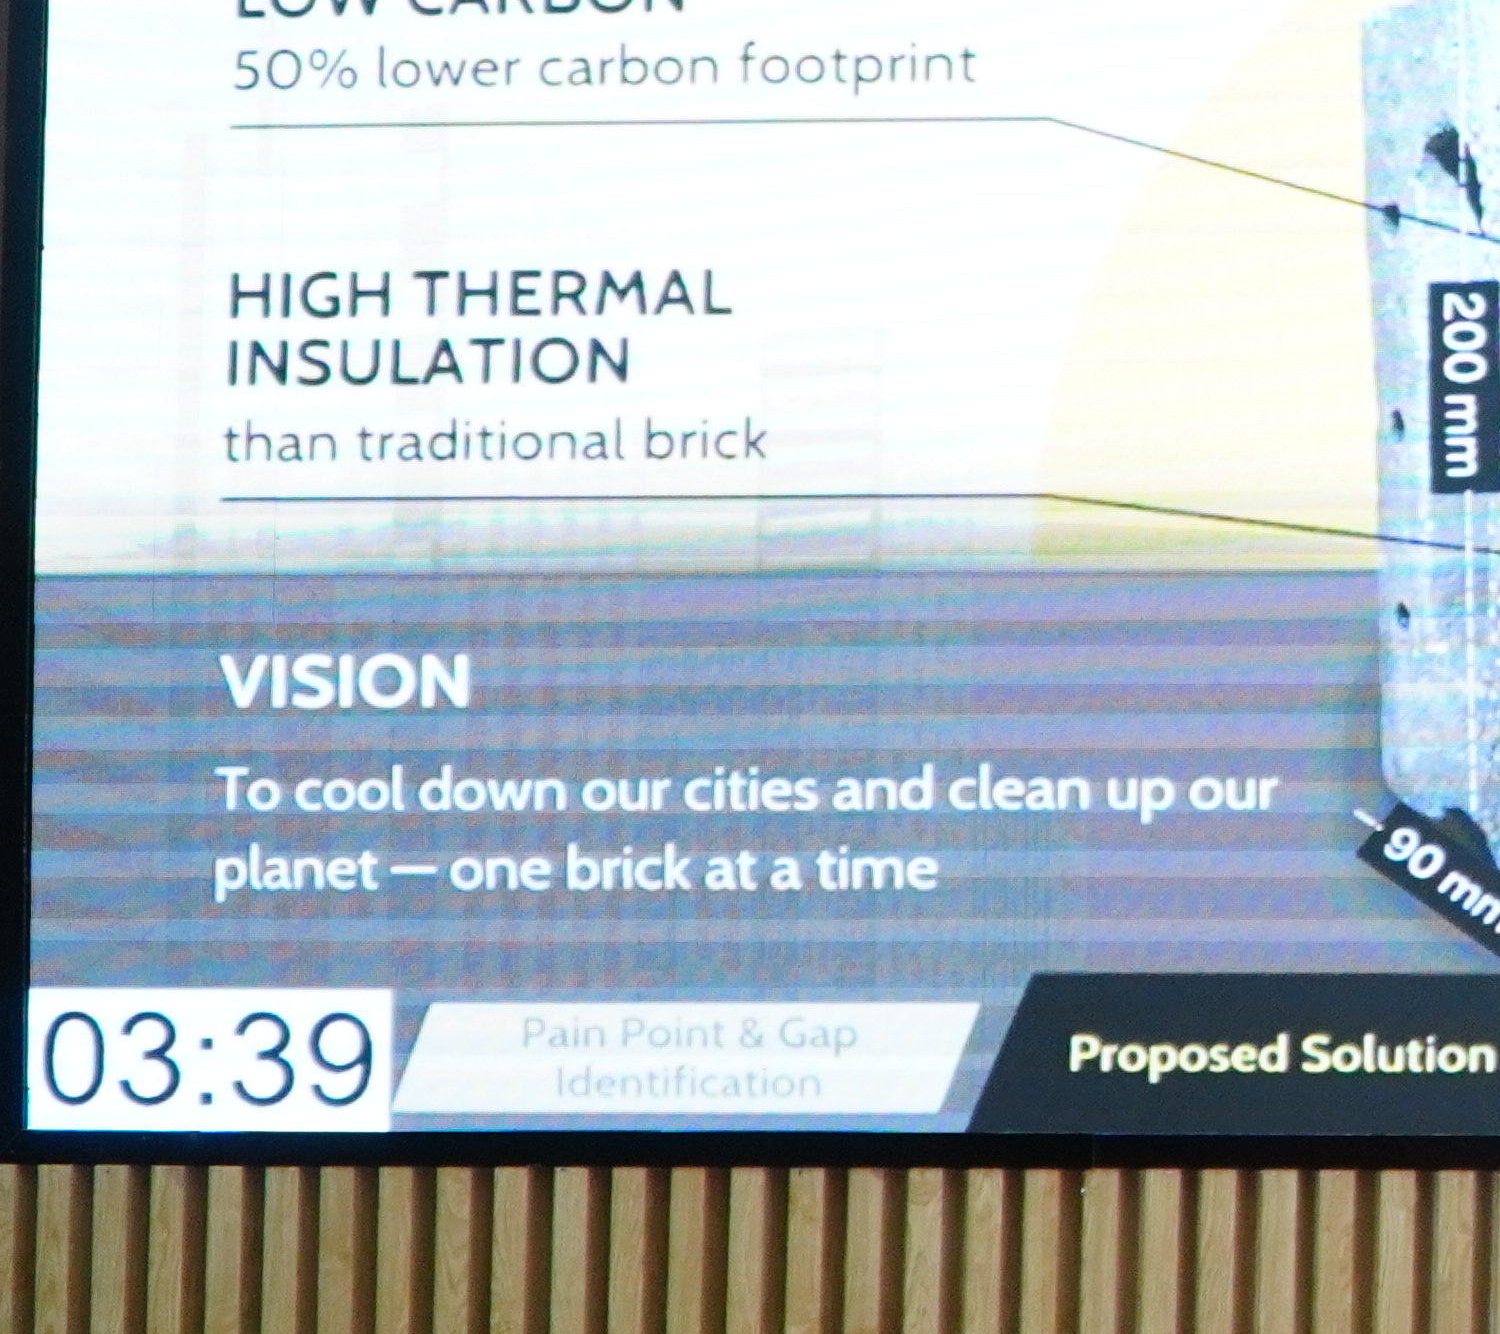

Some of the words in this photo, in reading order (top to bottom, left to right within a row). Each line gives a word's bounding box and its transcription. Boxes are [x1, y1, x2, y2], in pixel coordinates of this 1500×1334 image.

[235, 49, 357, 90] 50%
[379, 45, 520, 88] lower
[540, 43, 718, 86] carbon
[740, 41, 976, 95] footprint
[231, 272, 390, 318] HIGH
[413, 270, 732, 316] THERMAL
[229, 337, 628, 386] INSULATION
[1442, 290, 1487, 384] 200
[224, 420, 336, 462] than
[358, 418, 624, 462] traditional
[646, 417, 766, 460] brick
[1443, 392, 1477, 478] mm
[220, 653, 470, 708] VISION
[214, 767, 283, 811] To
[294, 765, 405, 812] cool
[419, 765, 567, 811] down
[582, 778, 671, 811] our
[685, 766, 821, 811] cities
[832, 763, 934, 811] and
[948, 763, 1092, 810] clean
[1108, 777, 1176, 824] up
[1189, 777, 1280, 810] our
[215, 842, 379, 903] planet
[450, 856, 552, 890] one
[567, 842, 691, 891] brick
[705, 850, 757, 891] at
[771, 857, 803, 890] a
[816, 846, 939, 890] time
[1382, 824, 1445, 884] 90
[44, 1012, 372, 1106] 03:39
[521, 1017, 602, 1051] Pain
[620, 1017, 726, 1051] Point
[739, 1017, 766, 1051] &
[774, 1017, 859, 1057] Gap
[1070, 1033, 1289, 1083] Proposed
[1302, 1033, 1497, 1073] Solution
[555, 1065, 822, 1100] Identification
